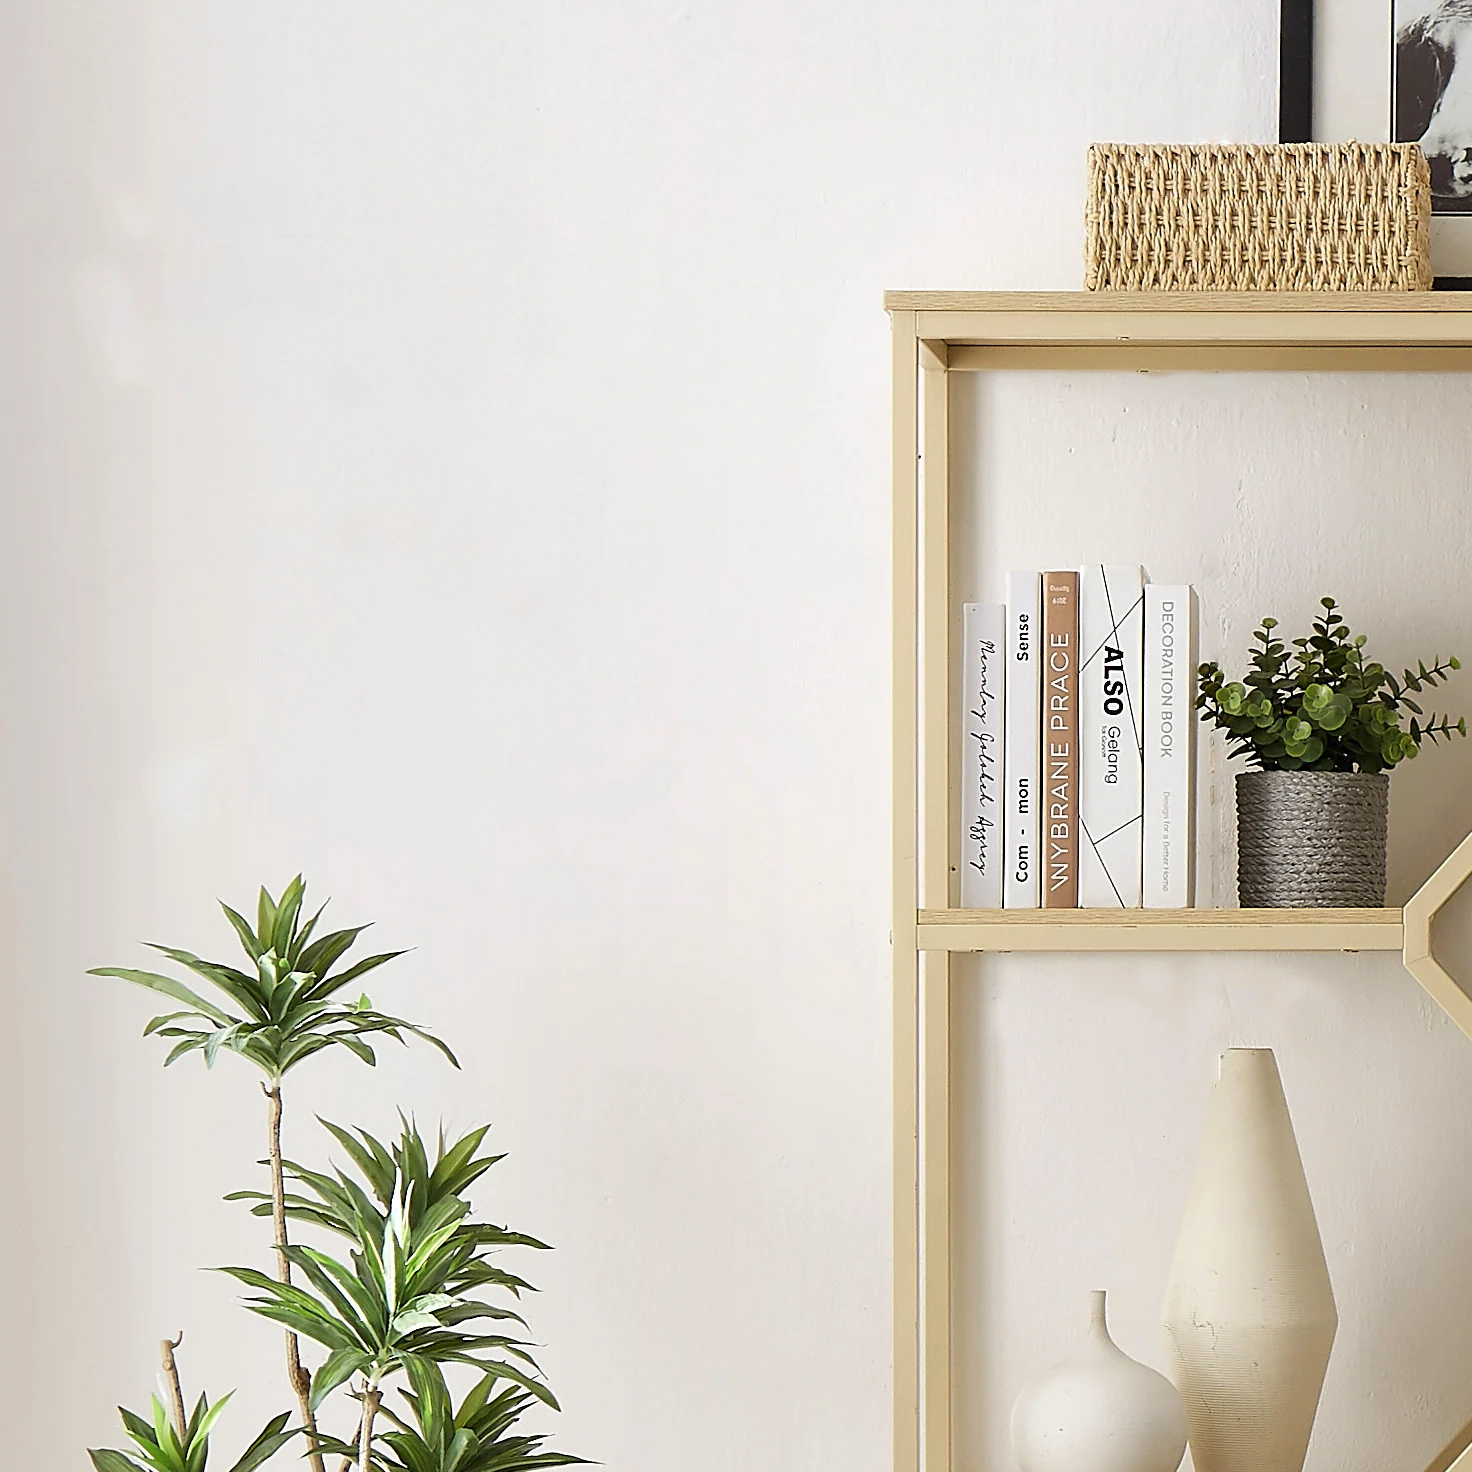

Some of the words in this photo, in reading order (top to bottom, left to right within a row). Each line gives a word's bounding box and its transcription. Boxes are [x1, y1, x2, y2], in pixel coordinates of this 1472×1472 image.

[1016, 613, 1029, 661] Sense
[1161, 601, 1174, 706] DECORATION
[1050, 633, 1069, 730] PRACE
[1103, 645, 1124, 716] ALSO
[1104, 726, 1121, 784] Gelang
[1160, 711, 1173, 758] BOOK
[1018, 778, 1029, 814] mon
[1050, 742, 1069, 892] WYBRANE
[1015, 845, 1029, 882] Com
